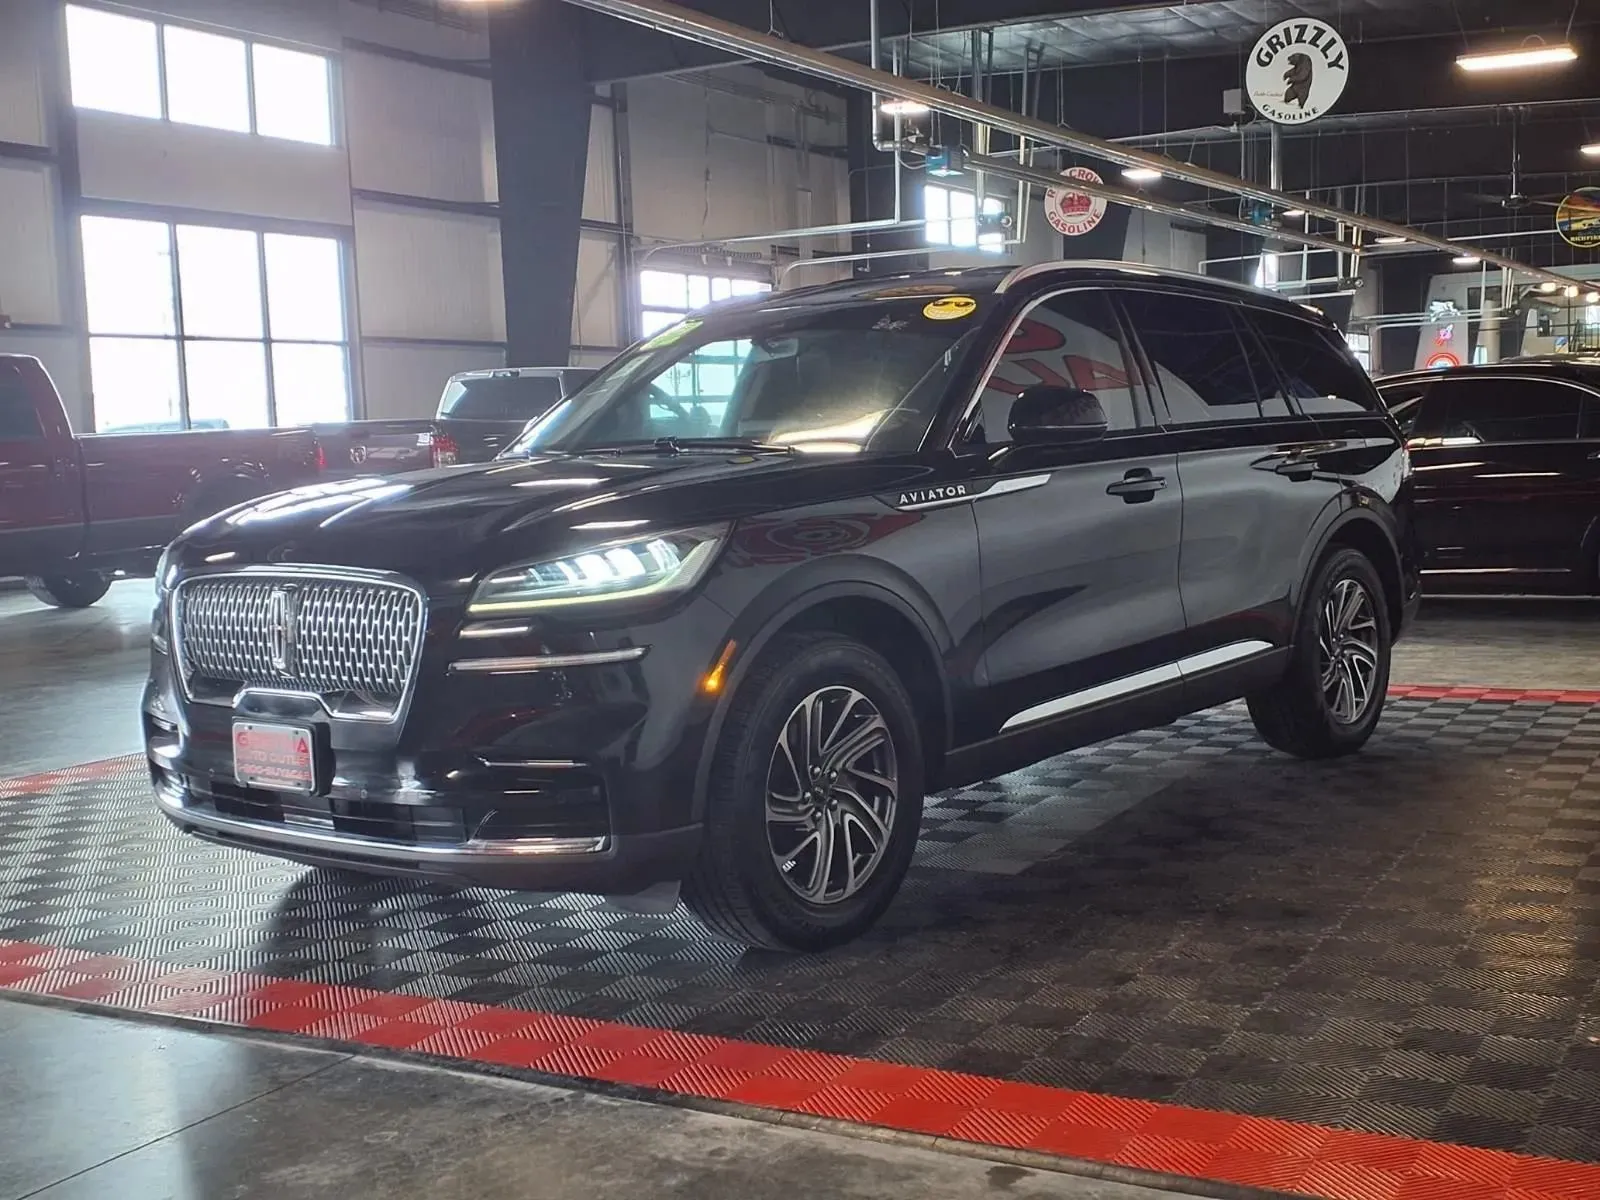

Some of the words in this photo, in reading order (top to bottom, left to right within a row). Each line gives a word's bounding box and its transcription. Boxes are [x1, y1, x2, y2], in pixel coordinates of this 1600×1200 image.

[1256, 24, 1345, 71] GRIZZLY
[1262, 104, 1319, 121] GASOLINE
[1048, 209, 1102, 234] GASOLINE
[900, 485, 966, 504] AVIATOR
